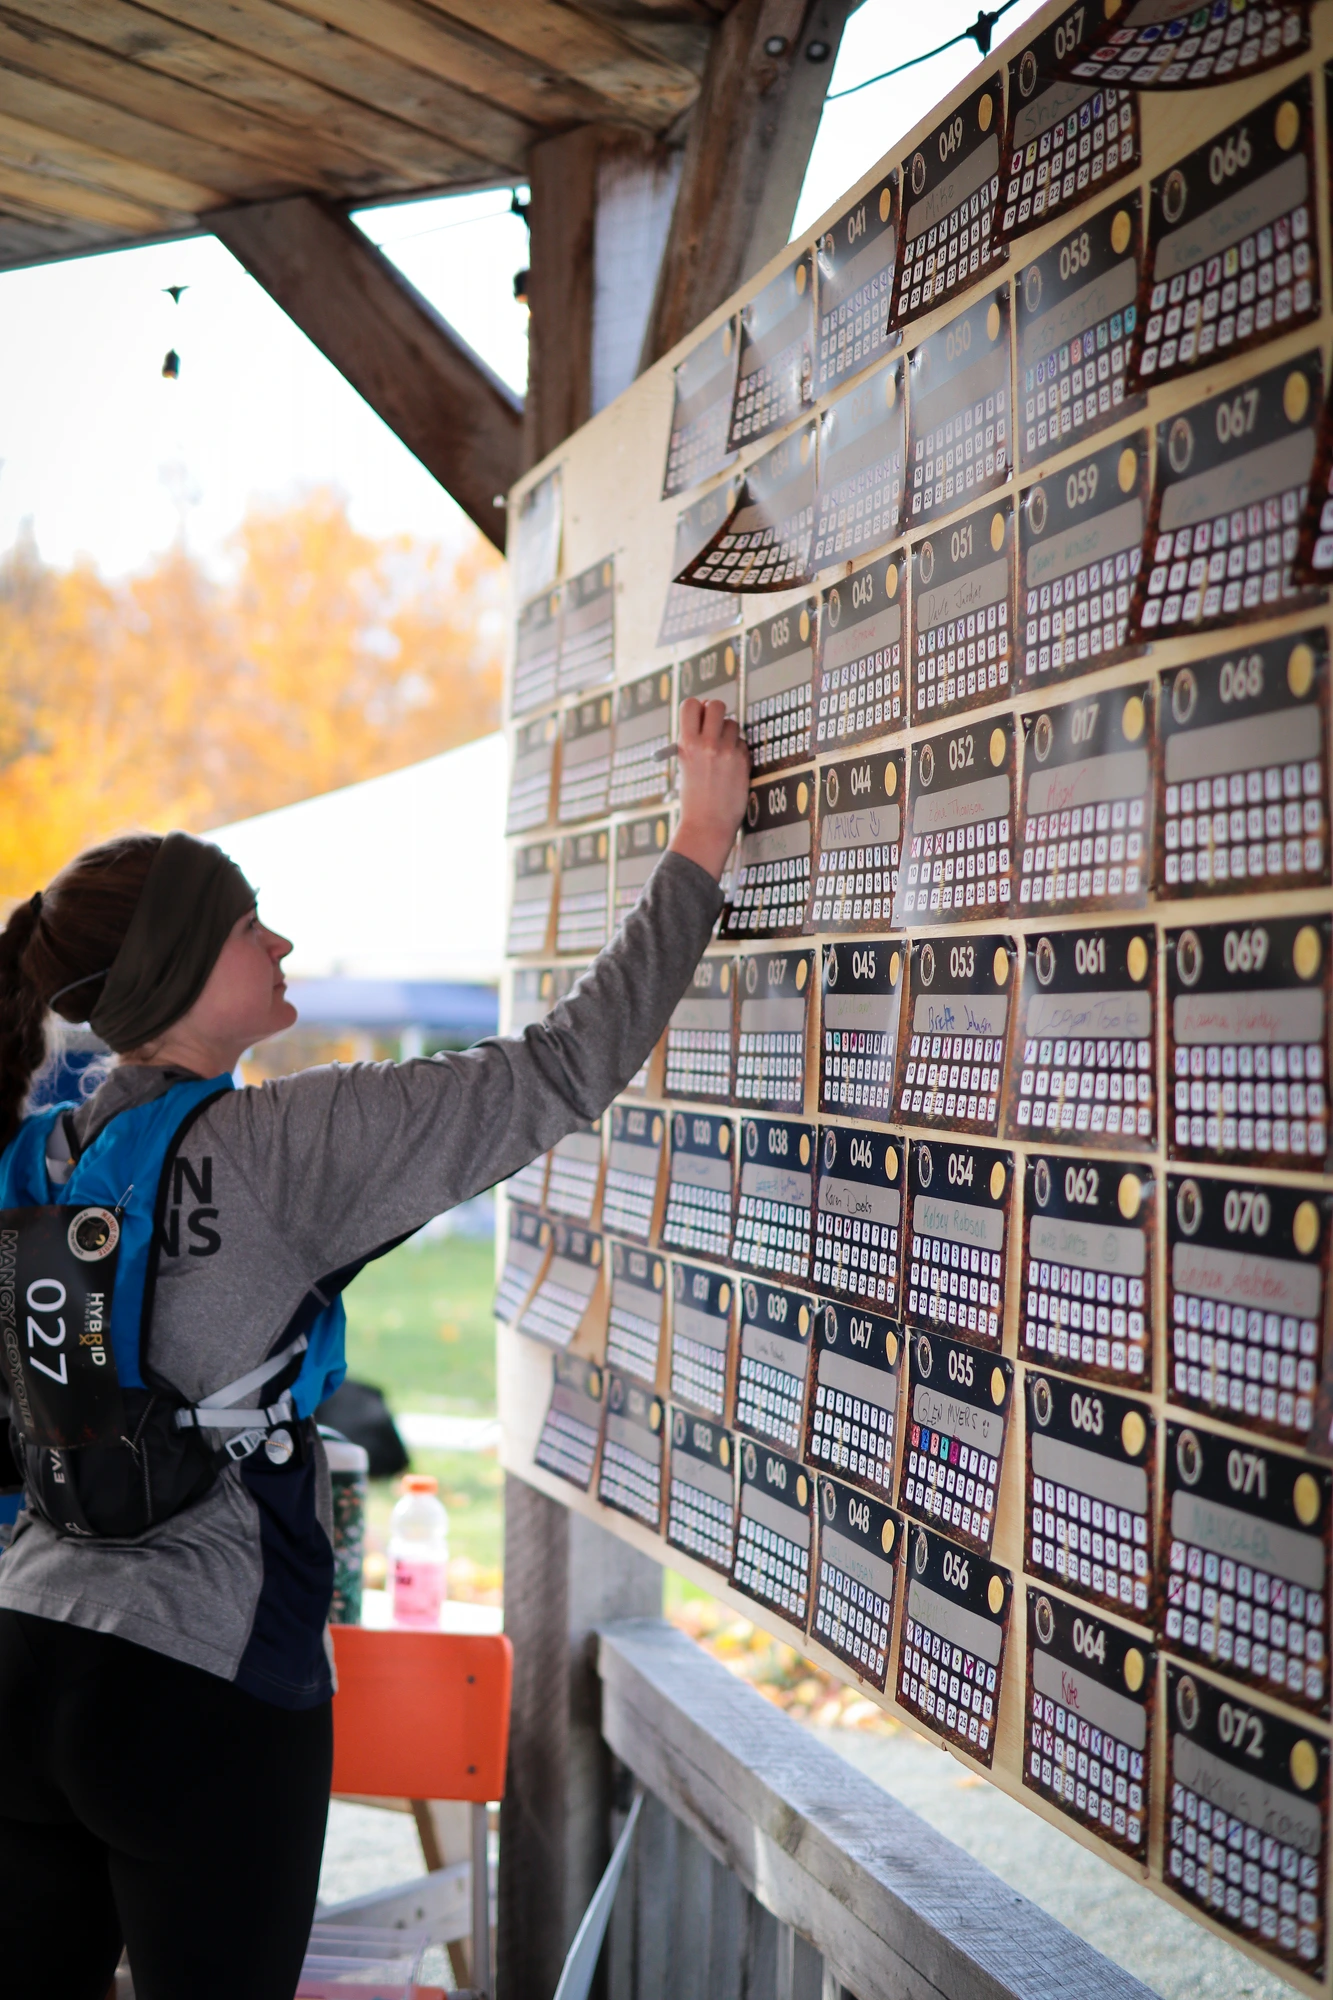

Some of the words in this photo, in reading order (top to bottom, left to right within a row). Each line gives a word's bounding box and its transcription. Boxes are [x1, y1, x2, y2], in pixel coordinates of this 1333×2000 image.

[1055, 7, 1084, 59] 057
[939, 117, 962, 162] 049
[1210, 129, 1251, 184] 066
[1007, 210, 1015, 223] 19
[1019, 202, 1030, 217] 20
[1035, 195, 1044, 208] 21
[1049, 185, 1059, 201] 22
[1065, 176, 1074, 192] 23
[1079, 168, 1088, 183] 24
[1093, 158, 1103, 174] 25
[1108, 150, 1117, 165] 26
[1122, 138, 1131, 156] 27
[848, 207, 865, 244] 041
[1060, 233, 1090, 280] 058
[901, 297, 908, 309] 19
[911, 290, 920, 304] 20
[924, 284, 931, 296] 21
[935, 276, 944, 290] 22
[948, 268, 955, 282] 23
[959, 261, 967, 275] 24
[971, 253, 978, 266] 25
[946, 321, 971, 361] 050
[1216, 390, 1258, 443] 067
[1067, 464, 1098, 508] 059
[951, 525, 972, 562] 051
[853, 574, 872, 608] 043
[928, 594, 949, 627] Dave
[771, 618, 789, 648] 035
[1220, 655, 1262, 703] 068
[1071, 704, 1100, 743] 017
[949, 735, 974, 770] 052
[851, 765, 871, 795] 044
[769, 786, 787, 815] 036
[853, 951, 875, 979] 045
[950, 946, 974, 977] 053
[1075, 938, 1105, 974] 061
[1224, 929, 1268, 972] 069
[768, 959, 787, 985] 037
[904, 1094, 910, 1104] 19
[913, 1094, 921, 1106] 20
[925, 1096, 932, 1107] 21
[936, 1097, 944, 1109] 22
[947, 1098, 955, 1110] 23
[958, 1100, 965, 1111] 24
[968, 1101, 976, 1112] 25
[979, 1102, 986, 1114] 26
[989, 1103, 996, 1115] 27
[769, 1128, 788, 1155] 038
[851, 1138, 872, 1168] 046
[948, 1154, 973, 1186] 054
[1065, 1167, 1099, 1204] 062
[1224, 1190, 1269, 1235] 070
[0, 1229, 18, 1326] MANGY
[816, 1266, 821, 1276] 19
[823, 1268, 829, 1279] 20
[832, 1270, 838, 1281] 21
[840, 1273, 847, 1284] 22
[850, 1275, 856, 1287] 23
[859, 1278, 866, 1289] 24
[868, 1281, 875, 1292] 25
[878, 1284, 885, 1295] 26
[888, 1286, 894, 1297] 27
[768, 1294, 787, 1322] 039
[25, 1278, 69, 1386] 027
[89, 1292, 107, 1367] HYBRID
[850, 1317, 872, 1349] 047
[3, 1328, 35, 1429] COYOTE
[949, 1350, 973, 1386] 055
[947, 1402, 977, 1434] MYERS
[1071, 1393, 1103, 1435] 063
[766, 1458, 786, 1489] 040
[1228, 1450, 1265, 1497] 071
[849, 1498, 869, 1533] 048
[943, 1551, 969, 1590] 056
[1073, 1619, 1105, 1664] 064
[1061, 1670, 1079, 1710] Kate
[1218, 1702, 1266, 1758] 072
[1033, 1758, 1039, 1770] 19
[1043, 1764, 1051, 1778] 20
[1054, 1772, 1061, 1786] 21
[1066, 1779, 1074, 1795] 22
[1077, 1788, 1086, 1803] 23
[1089, 1796, 1098, 1811] 24
[1101, 1804, 1111, 1819] 25
[1114, 1813, 1125, 1828] 26
[1128, 1818, 1139, 1835] 27
